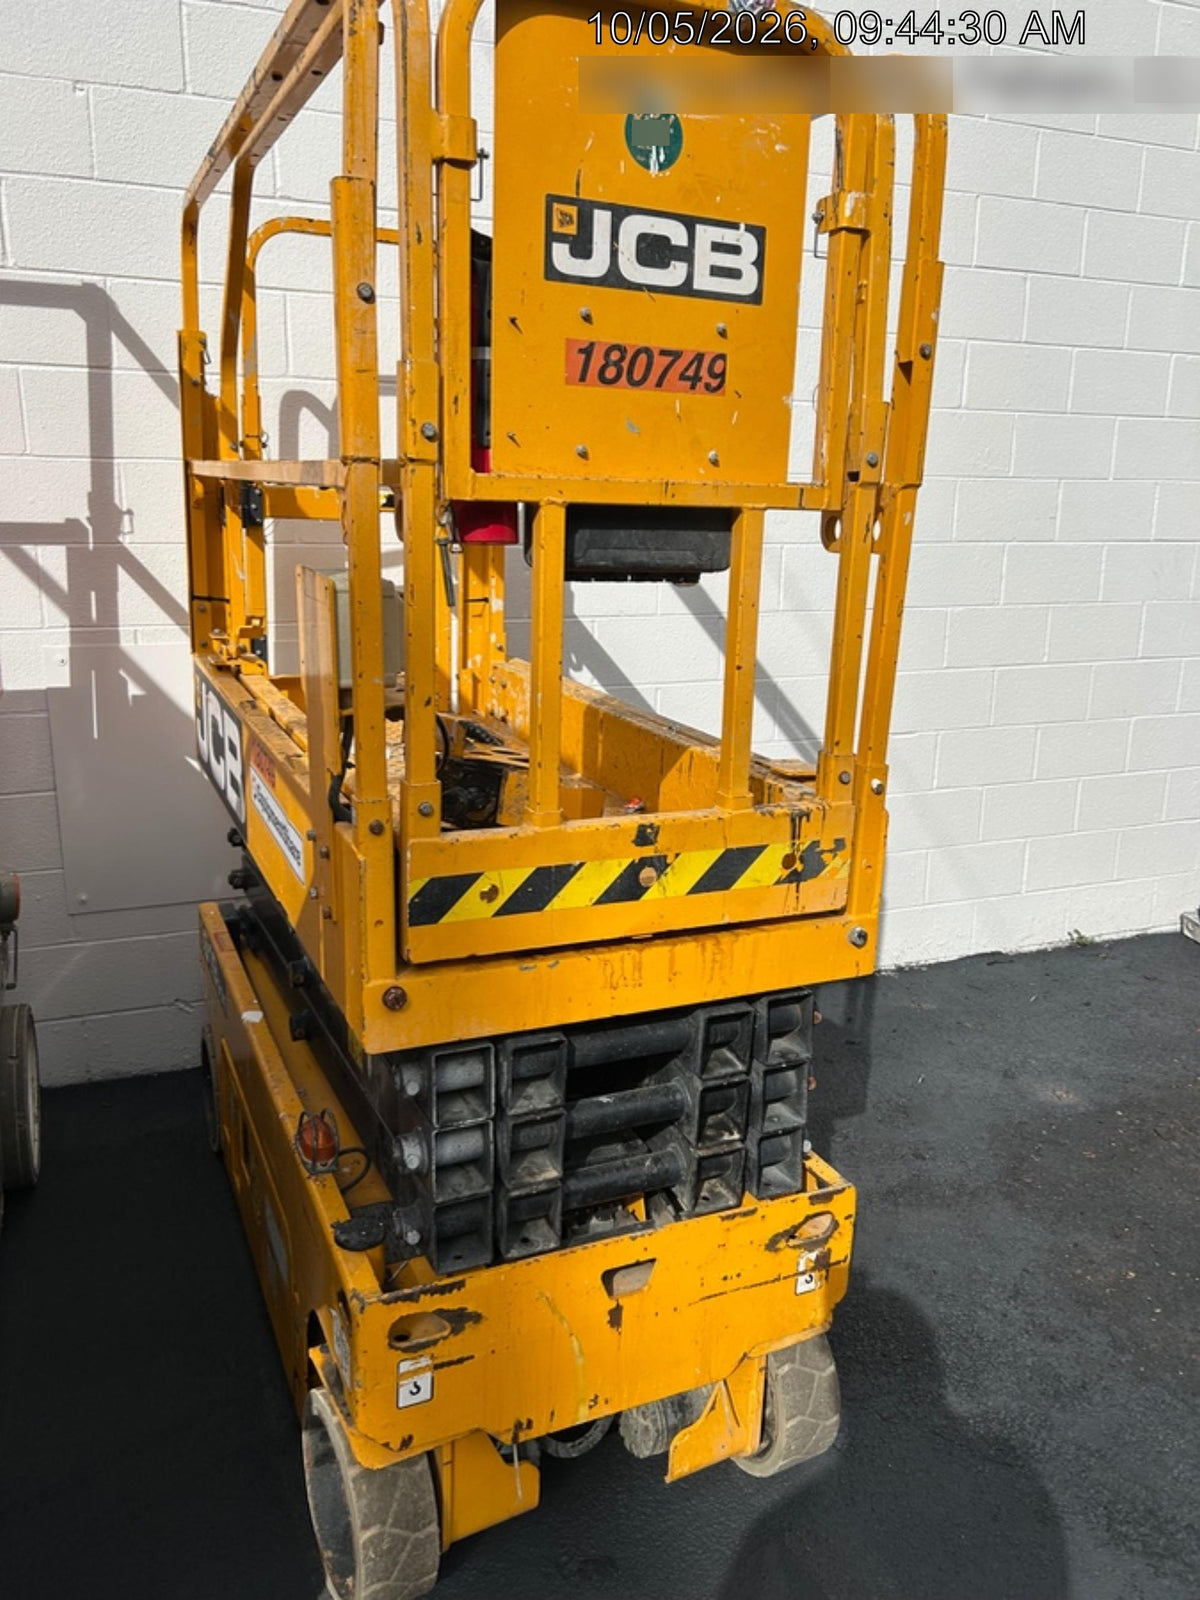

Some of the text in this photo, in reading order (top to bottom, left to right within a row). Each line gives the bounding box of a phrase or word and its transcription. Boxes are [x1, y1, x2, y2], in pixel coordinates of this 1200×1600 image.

[552, 208, 759, 296] JCB
[577, 341, 728, 393] 180749
[197, 681, 246, 825] JCB
